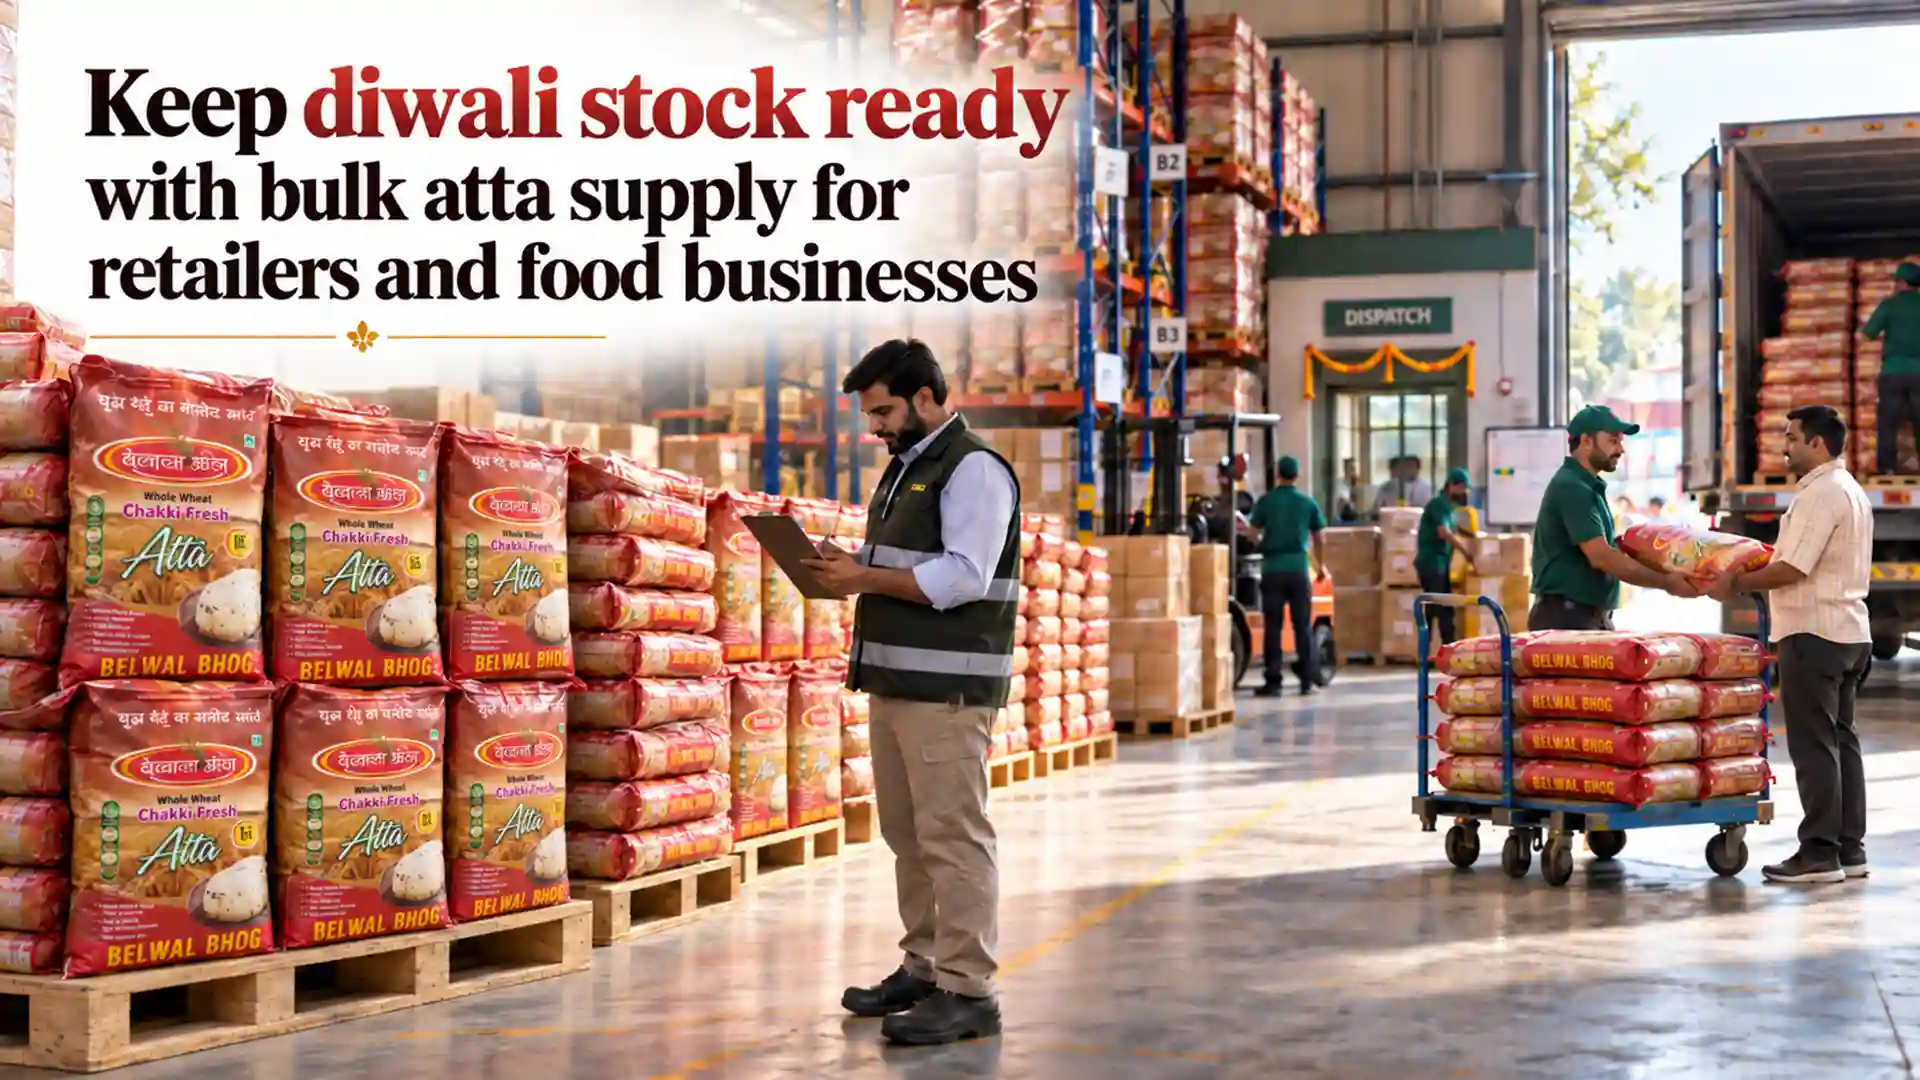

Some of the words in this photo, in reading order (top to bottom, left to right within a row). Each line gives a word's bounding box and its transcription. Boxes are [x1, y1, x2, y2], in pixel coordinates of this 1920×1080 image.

[1157, 154, 1180, 171] B2
[1345, 307, 1432, 326] DISPATCH
[1157, 327, 1179, 344] B3
[144, 491, 176, 503] Whole
[179, 492, 212, 504] Wheat
[123, 503, 181, 520] Chakki
[186, 506, 230, 522] Fresh
[322, 530, 370, 544] Chakki
[373, 533, 409, 546] Fresh
[120, 524, 215, 580] Atta
[321, 549, 396, 596] Atta
[493, 556, 544, 597] Atta
[101, 652, 188, 677] BELWAL
[197, 651, 254, 674] BHOG
[300, 659, 375, 681] BELWAL
[383, 656, 433, 678] BHOG
[475, 651, 532, 673] BELWAL
[1532, 653, 1578, 668] BELWAL
[1532, 694, 1577, 710] BELWAL
[1532, 734, 1577, 751] BELWAL
[1532, 776, 1579, 792] BELWAL
[157, 795, 189, 805] Whole
[339, 797, 383, 810] Chakki
[387, 794, 420, 807] Fresh
[138, 807, 192, 822] Chakki
[197, 805, 238, 818] Fresh
[495, 803, 545, 844] Atta
[338, 813, 408, 861] Atta
[136, 824, 222, 875] Atta
[474, 891, 528, 917] BELWAL
[313, 914, 386, 941] BELWAL
[393, 905, 441, 931] BHOG
[107, 937, 197, 967] BELWAL
[206, 928, 262, 954] BHOG
